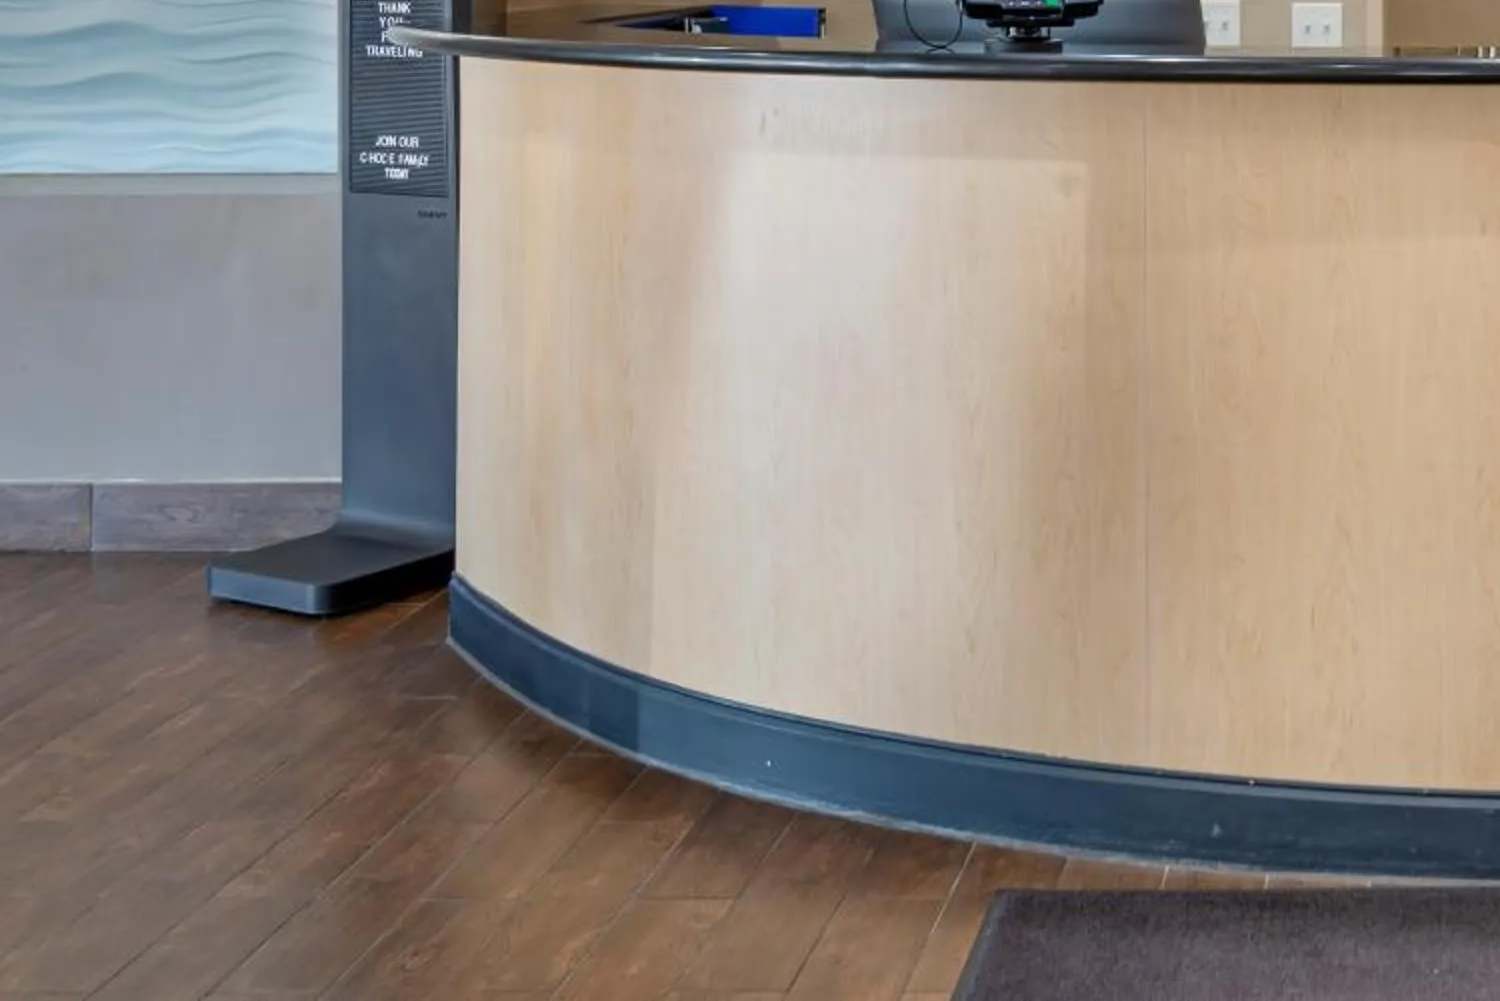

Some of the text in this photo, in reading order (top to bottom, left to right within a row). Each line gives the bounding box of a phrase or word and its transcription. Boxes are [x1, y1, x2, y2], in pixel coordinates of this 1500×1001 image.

[378, 2, 411, 14] THANK
[375, 135, 419, 148] JOIN OUR
[384, 167, 409, 180] TODAY
